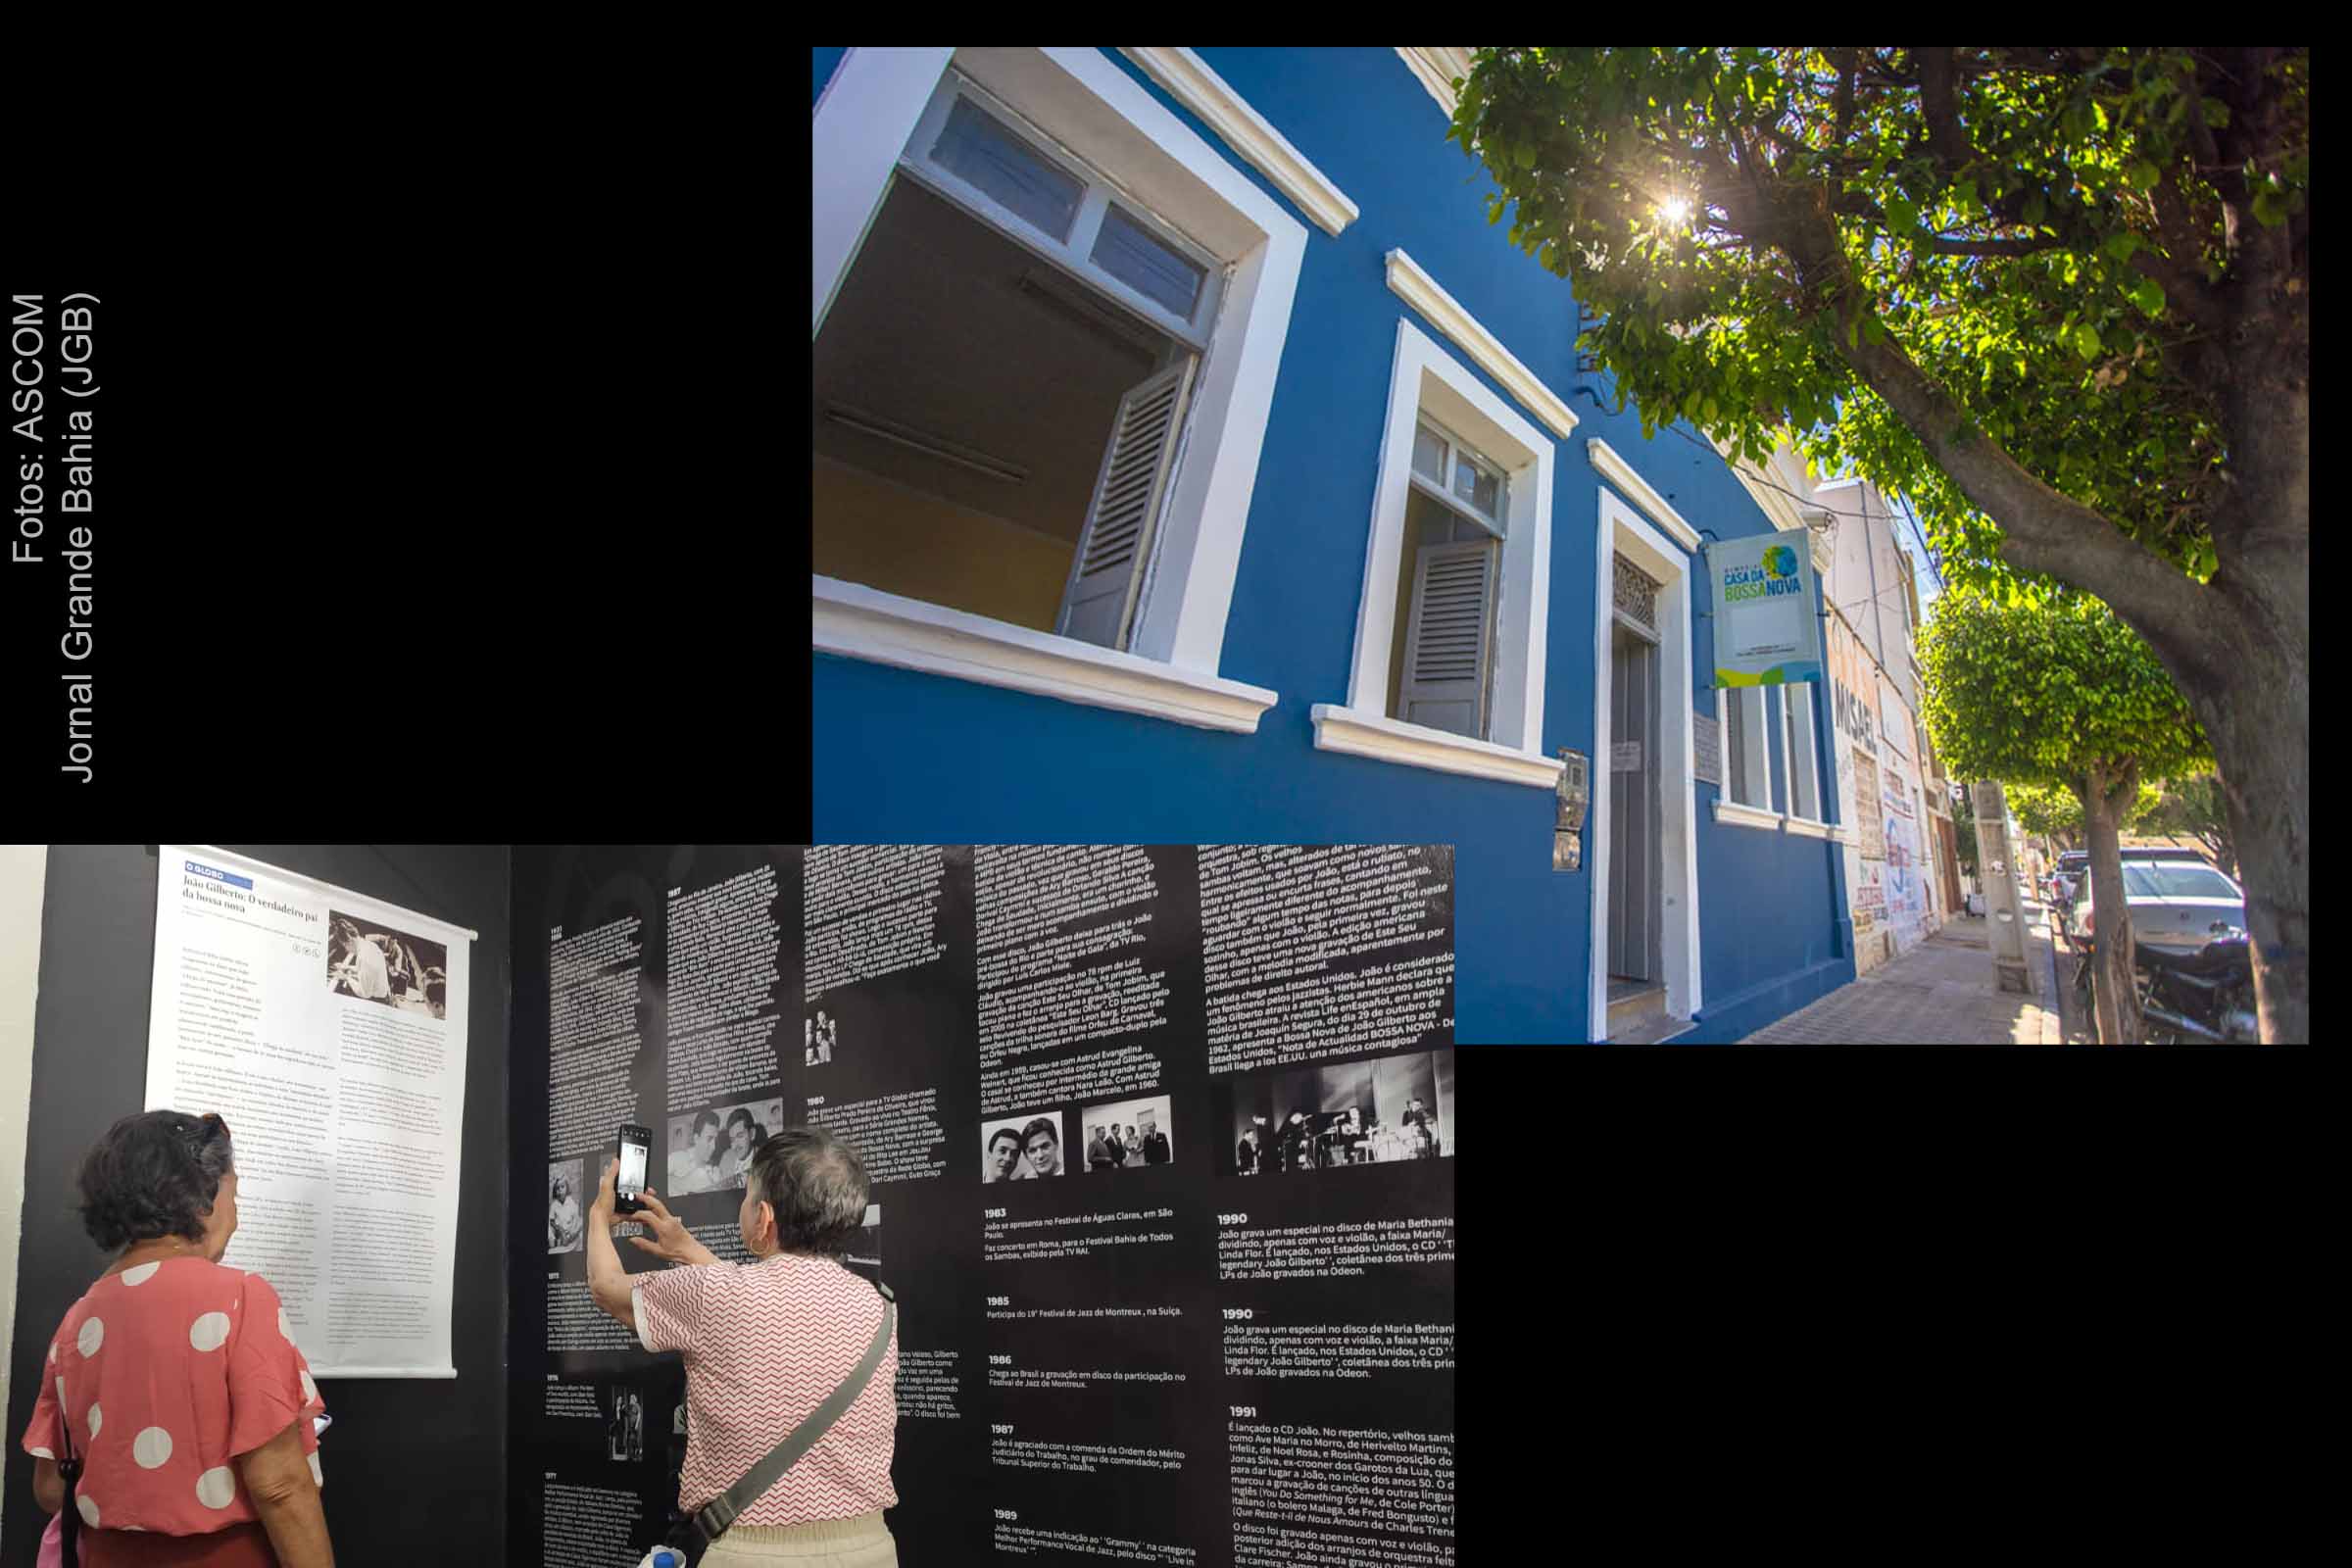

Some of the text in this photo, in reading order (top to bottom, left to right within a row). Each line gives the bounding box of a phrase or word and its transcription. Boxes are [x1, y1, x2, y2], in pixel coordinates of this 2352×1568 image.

[1725, 569, 1764, 585] CASA DA
[182, 887, 245, 913] da bossa nova
[184, 874, 204, 887] João
[248, 894, 256, 904] O
[258, 899, 304, 918] verdadeiro
[305, 912, 318, 922] pai
[985, 1207, 1006, 1219] 1983
[1217, 1213, 1248, 1225] 1990
[1218, 1228, 1239, 1240] João
[1241, 1229, 1264, 1240] grava
[1266, 1228, 1281, 1237] um
[1283, 1223, 1320, 1237] especial
[1336, 1222, 1361, 1233] disco
[1363, 1221, 1376, 1231] de
[1377, 1220, 1405, 1230] Maria
[1407, 1217, 1453, 1229] Bethania
[1218, 1237, 1262, 1249] dividindo,
[1263, 1238, 1296, 1249] apenas
[1298, 1237, 1317, 1246] com
[1345, 1232, 1379, 1243] violão,
[1387, 1231, 1410, 1241] faixa
[1412, 1229, 1446, 1240] Maria/
[1218, 1249, 1243, 1259] Linda
[1245, 1248, 1265, 1258] Flor.
[1265, 1246, 1271, 1257] É
[1273, 1246, 1314, 1258] lançado,
[1314, 1247, 1331, 1255] nos
[1333, 1244, 1370, 1254] Estados
[1372, 1242, 1411, 1252] Unidos,
[1421, 1241, 1436, 1250] CD
[1219, 1258, 1262, 1271] legendary
[1265, 1257, 1287, 1268] João
[1336, 1253, 1383, 1265] coletânea
[1385, 1252, 1403, 1263] dos
[1404, 1251, 1425, 1262] três
[1220, 1270, 1235, 1280] LPs
[1237, 1269, 1248, 1279] de
[1250, 1268, 1271, 1279] João
[1273, 1267, 1315, 1280] gravados
[1330, 1266, 1365, 1276] Odeon.
[987, 1296, 1009, 1306] 1985
[1223, 1308, 1252, 1319] 1990
[1223, 1324, 1245, 1335] João
[1246, 1326, 1270, 1336] grava
[1288, 1324, 1326, 1336] especial
[1342, 1324, 1368, 1334] disco
[1369, 1324, 1383, 1334] de
[1384, 1324, 1412, 1334] Maria
[1223, 1334, 1269, 1346] dividindo,
[1269, 1337, 1301, 1347] apenas
[1350, 1335, 1385, 1347] violão,
[1394, 1335, 1418, 1346] faixa
[1420, 1336, 1453, 1346] Maria/
[989, 1354, 1011, 1364] 1986
[1224, 1366, 1241, 1376] LPs
[1242, 1366, 1253, 1376] de
[1255, 1366, 1277, 1377] João
[1279, 1367, 1320, 1379] gravados
[1336, 1367, 1370, 1378] Odeon.
[1230, 1405, 1256, 1418] 1991
[991, 1424, 1014, 1435] 1987
[1228, 1419, 1234, 1431] É
[1235, 1421, 1271, 1434] lançado
[1280, 1424, 1294, 1434] CD
[1296, 1425, 1321, 1436] João.
[1322, 1426, 1337, 1437] No
[1338, 1428, 1392, 1441] repertório,
[1392, 1430, 1426, 1441] velhos
[1228, 1435, 1253, 1444] como
[1254, 1434, 1271, 1445] Ave
[1273, 1435, 1298, 1446] Maria
[1314, 1438, 1347, 1449] Morro,
[1347, 1439, 1359, 1449] de
[1361, 1440, 1406, 1452] Herivelto
[1408, 1443, 1452, 1456] Martins,
[994, 1508, 1017, 1520] 1989
